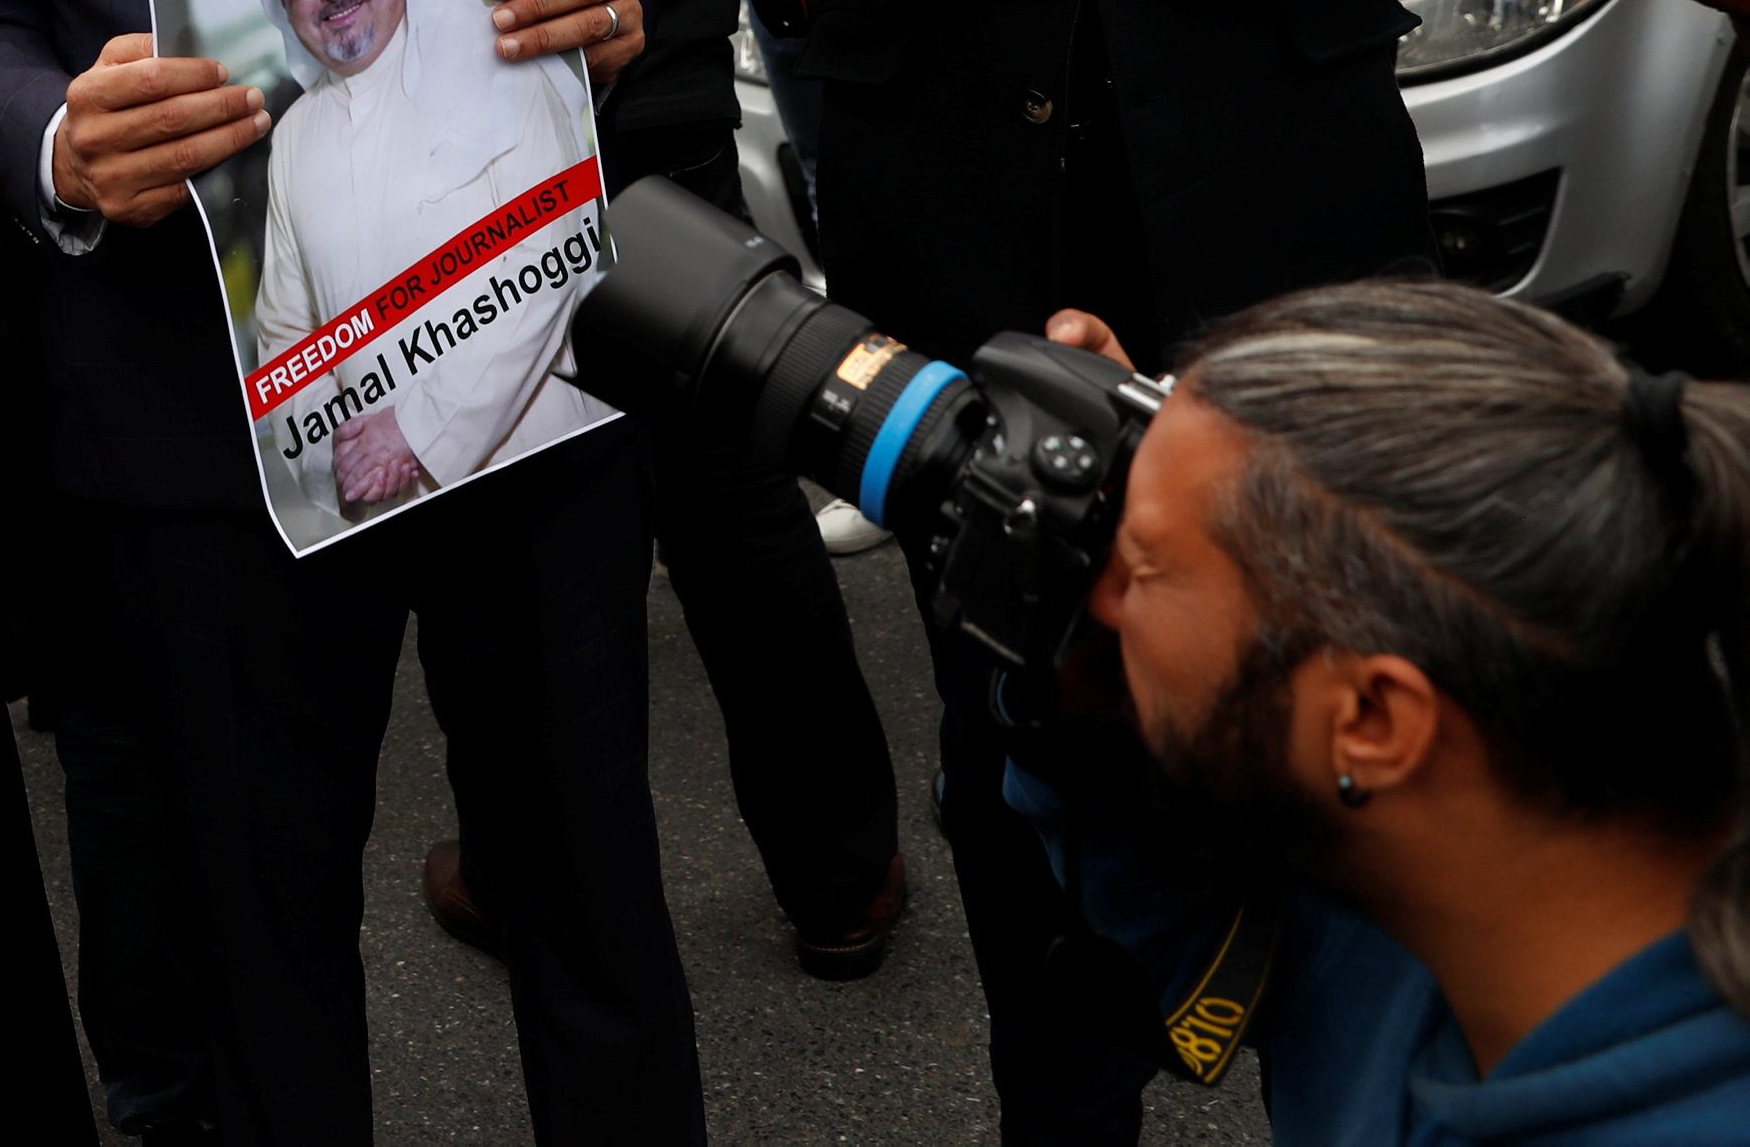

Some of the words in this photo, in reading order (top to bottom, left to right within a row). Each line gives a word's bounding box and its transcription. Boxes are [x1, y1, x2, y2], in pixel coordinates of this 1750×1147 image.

[255, 308, 376, 405] FREEDOM
[376, 275, 426, 322] FOR
[430, 179, 570, 286] JOURNALIST
[281, 354, 397, 460] Jamal
[398, 217, 602, 375] Khashoggi
